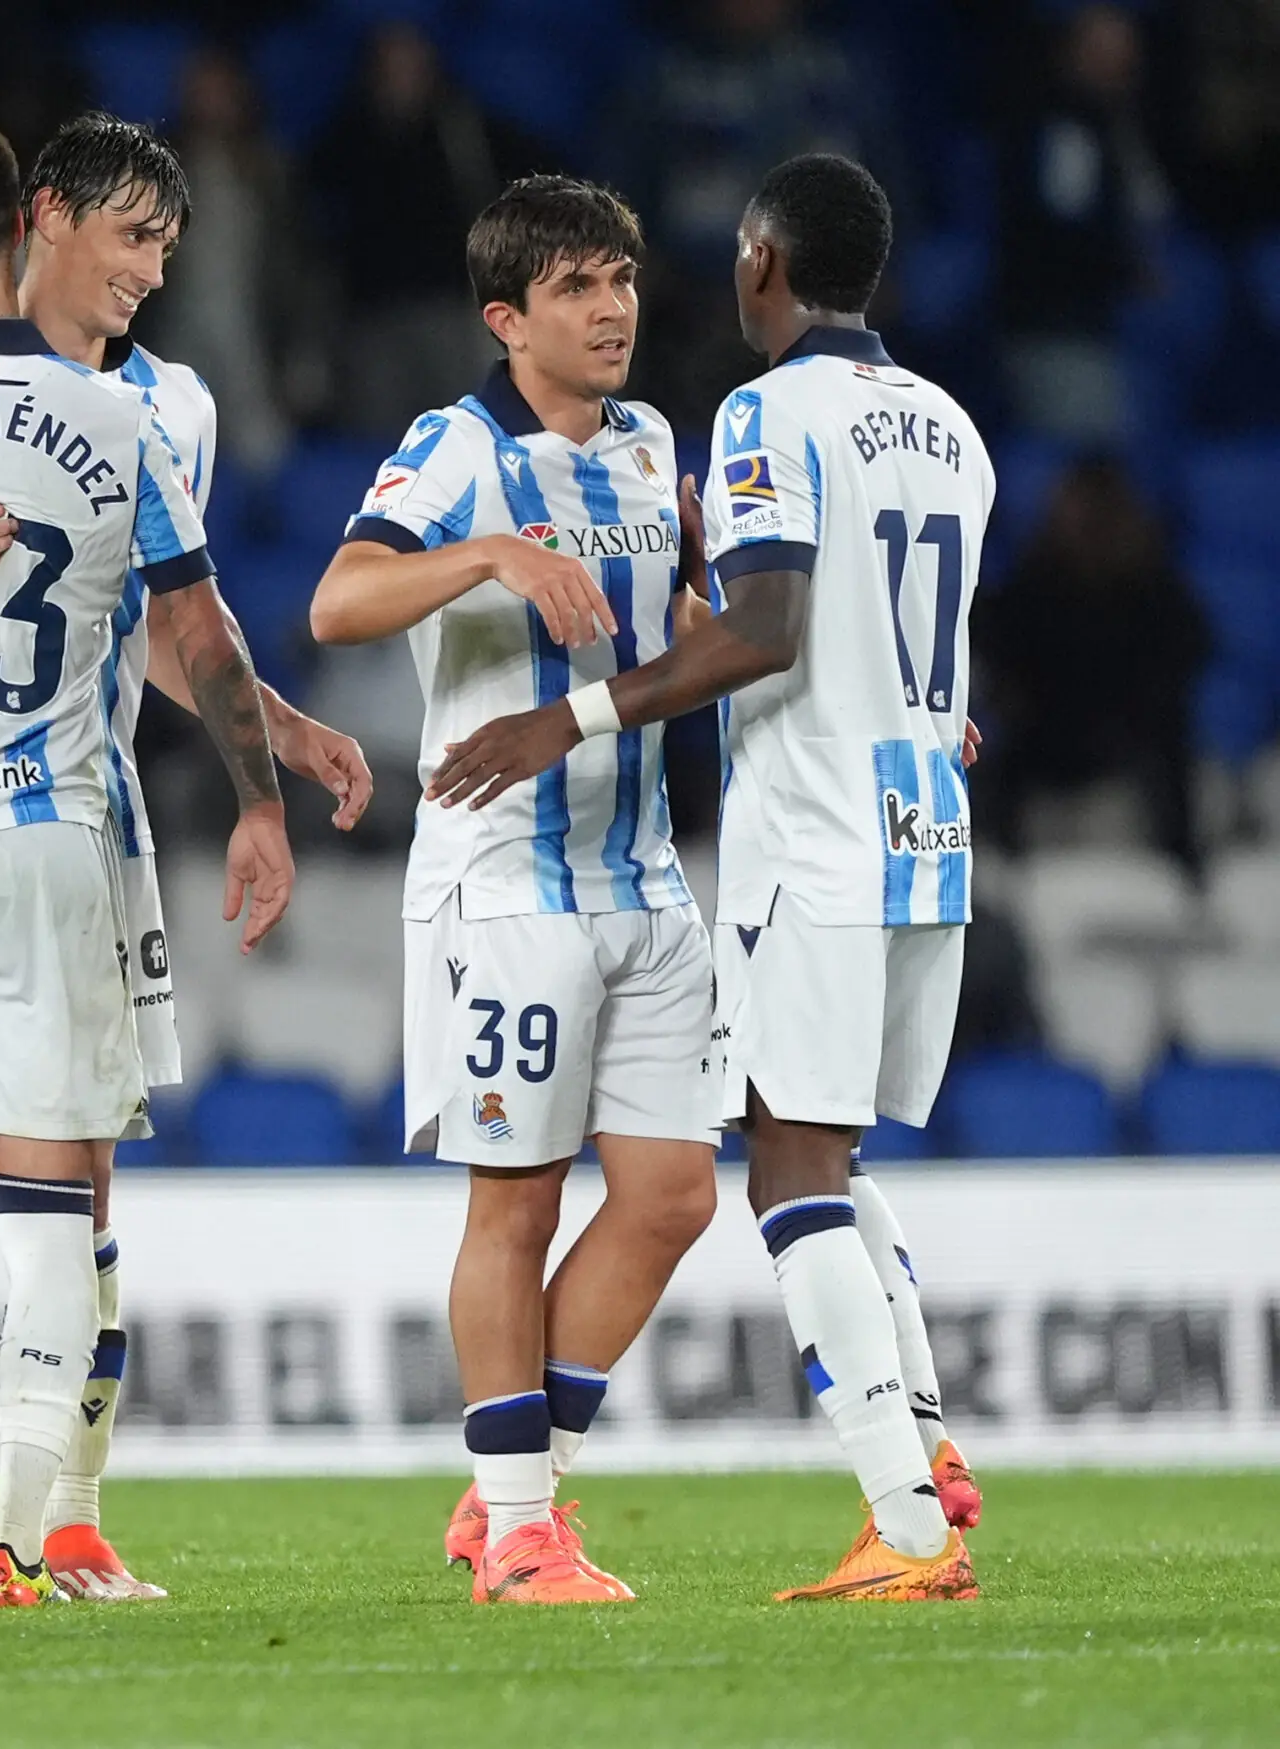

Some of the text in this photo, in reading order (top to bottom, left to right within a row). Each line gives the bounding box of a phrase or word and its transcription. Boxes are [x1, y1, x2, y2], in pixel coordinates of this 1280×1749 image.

[850, 410, 961, 474] BECKER
[566, 524, 678, 557] YASUDA
[874, 509, 962, 714] 11
[466, 998, 558, 1084] 39
[20, 1347, 62, 1367] RS
[866, 1379, 900, 1401] RS
